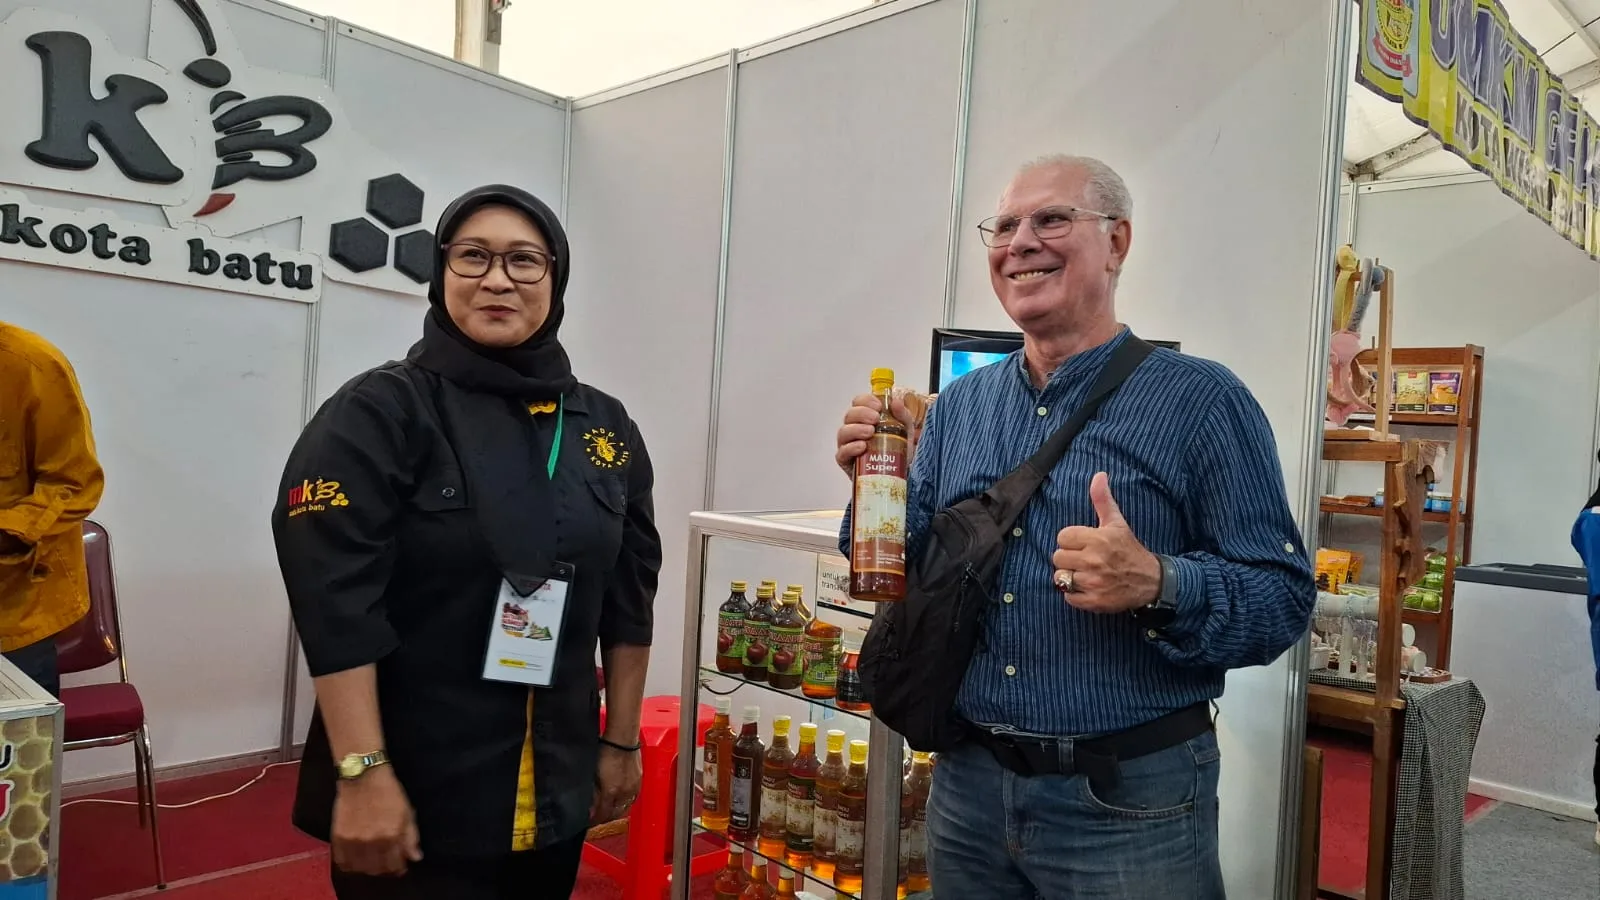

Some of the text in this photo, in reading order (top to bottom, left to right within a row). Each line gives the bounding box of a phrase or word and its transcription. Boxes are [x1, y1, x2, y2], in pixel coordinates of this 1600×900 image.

[1455, 91, 1501, 169] KOTA
[0, 203, 314, 290] kota batu
[865, 463, 898, 473] Super
[869, 454, 896, 463] MADU
